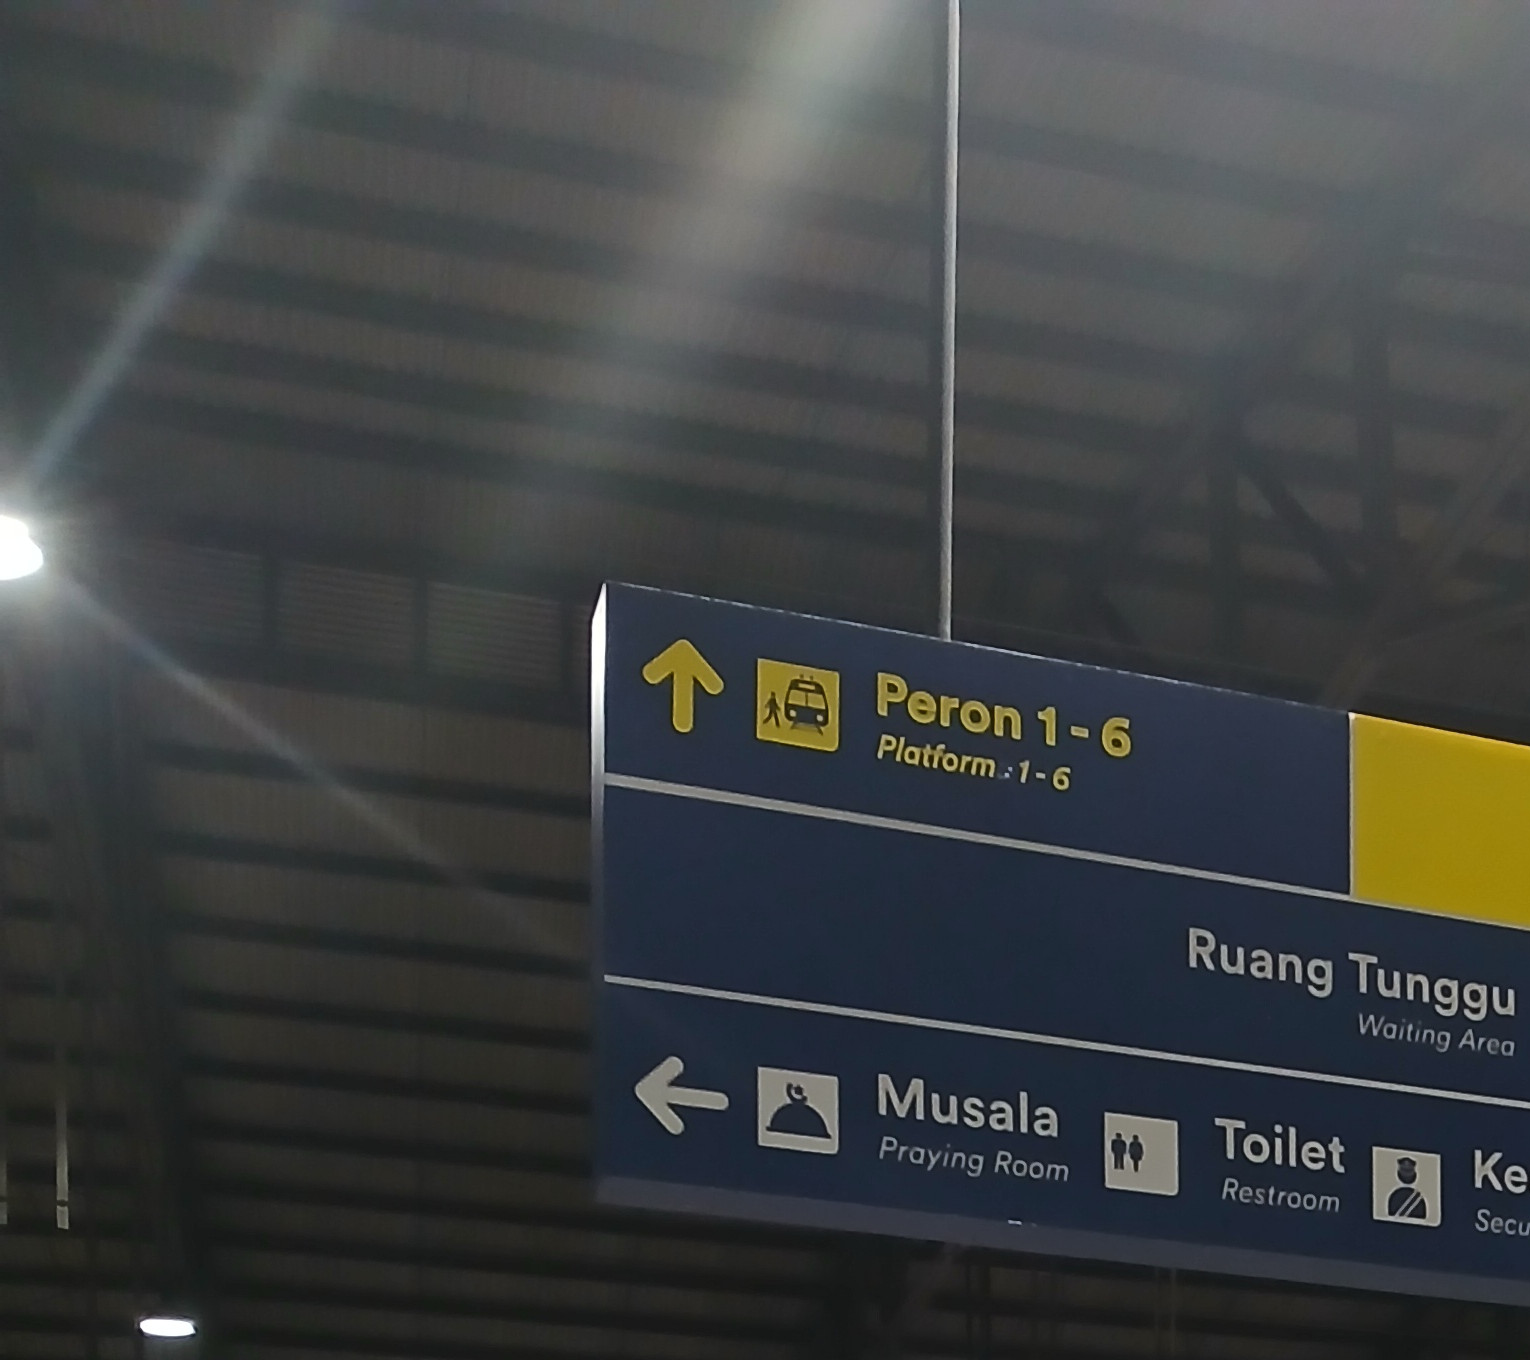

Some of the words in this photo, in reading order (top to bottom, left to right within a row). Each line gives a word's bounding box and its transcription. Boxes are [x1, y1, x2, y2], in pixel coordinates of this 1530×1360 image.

[876, 671, 1021, 741] Peron
[877, 734, 997, 780] Platform
[1187, 926, 1335, 998] Ruang
[1348, 952, 1517, 1018] Tunggu
[1358, 1012, 1453, 1054] Waiting
[1459, 1033, 1516, 1058] Area
[877, 1072, 1060, 1140] Musala
[879, 1135, 985, 1179] Praying
[993, 1148, 1071, 1184] Room
[1215, 1116, 1346, 1174] Toilet
[1221, 1176, 1341, 1214] Restroom
